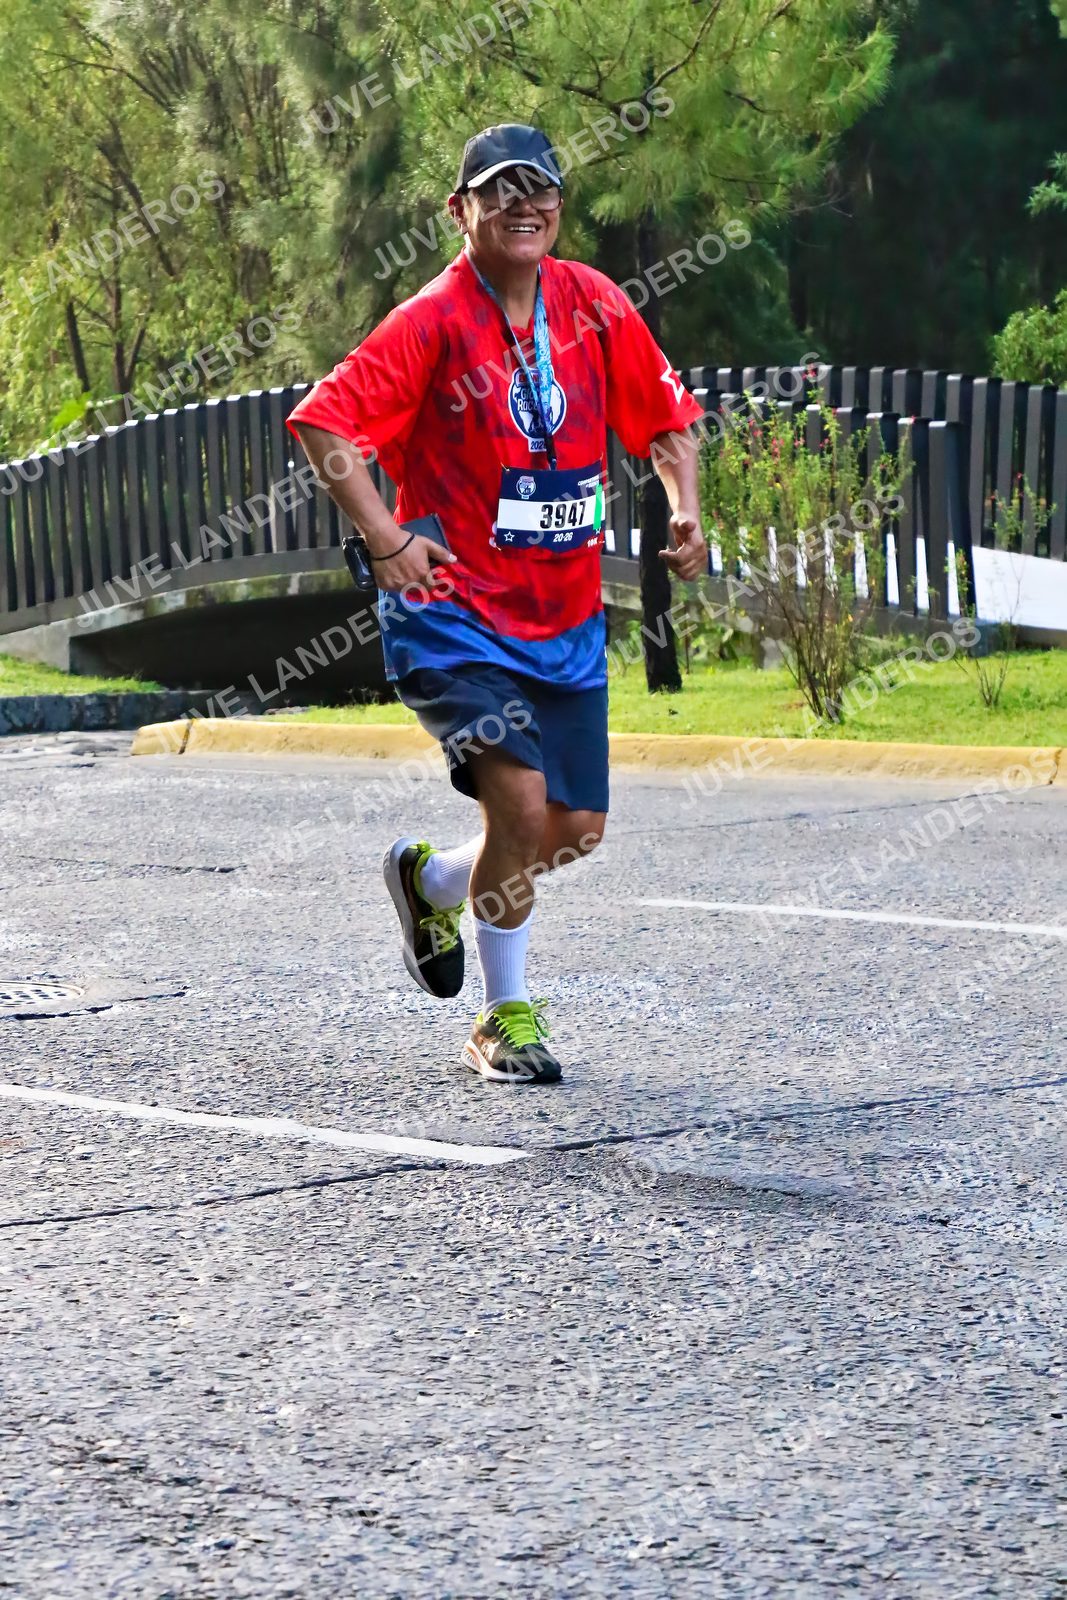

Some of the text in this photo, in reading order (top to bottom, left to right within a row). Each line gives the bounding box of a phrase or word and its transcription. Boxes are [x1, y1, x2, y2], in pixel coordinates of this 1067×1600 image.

[530, 440, 546, 450] 202
[540, 500, 586, 529] 3947
[553, 531, 574, 543] 20-26
